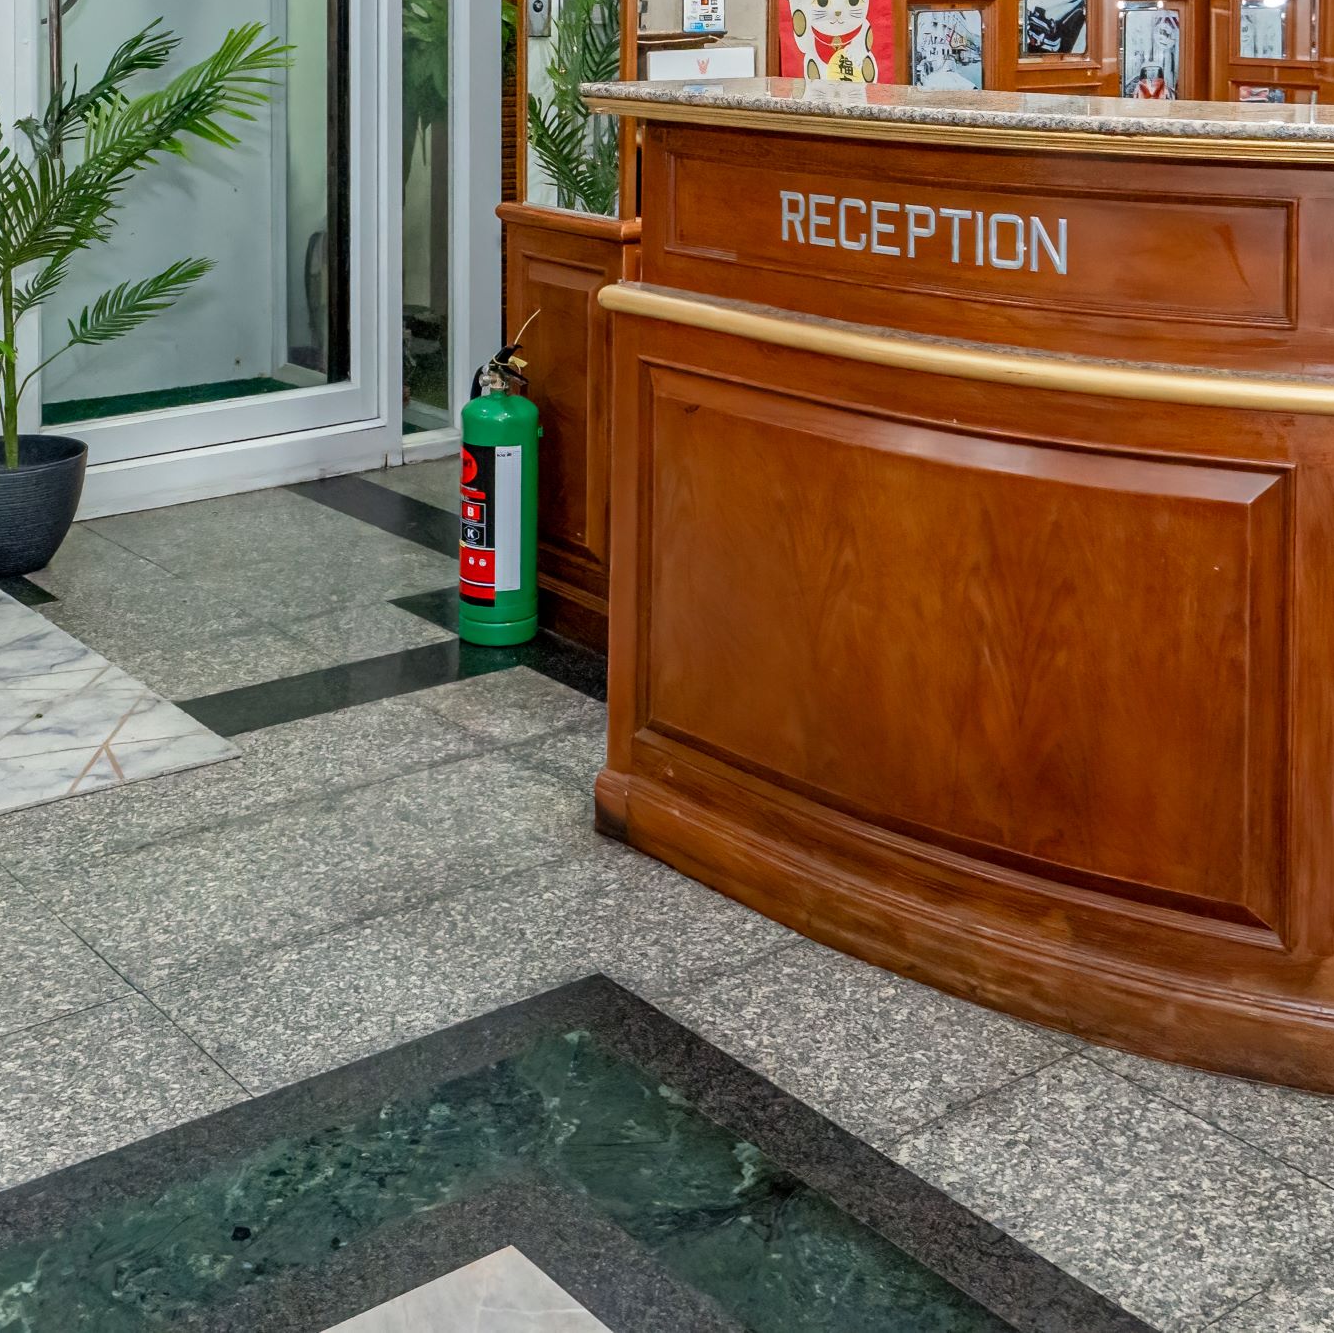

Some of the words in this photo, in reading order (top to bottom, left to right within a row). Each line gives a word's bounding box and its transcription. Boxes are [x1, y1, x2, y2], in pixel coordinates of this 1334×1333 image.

[780, 190, 1067, 275] RECEPTION
[467, 506, 475, 517] B
[467, 528, 475, 539] K
